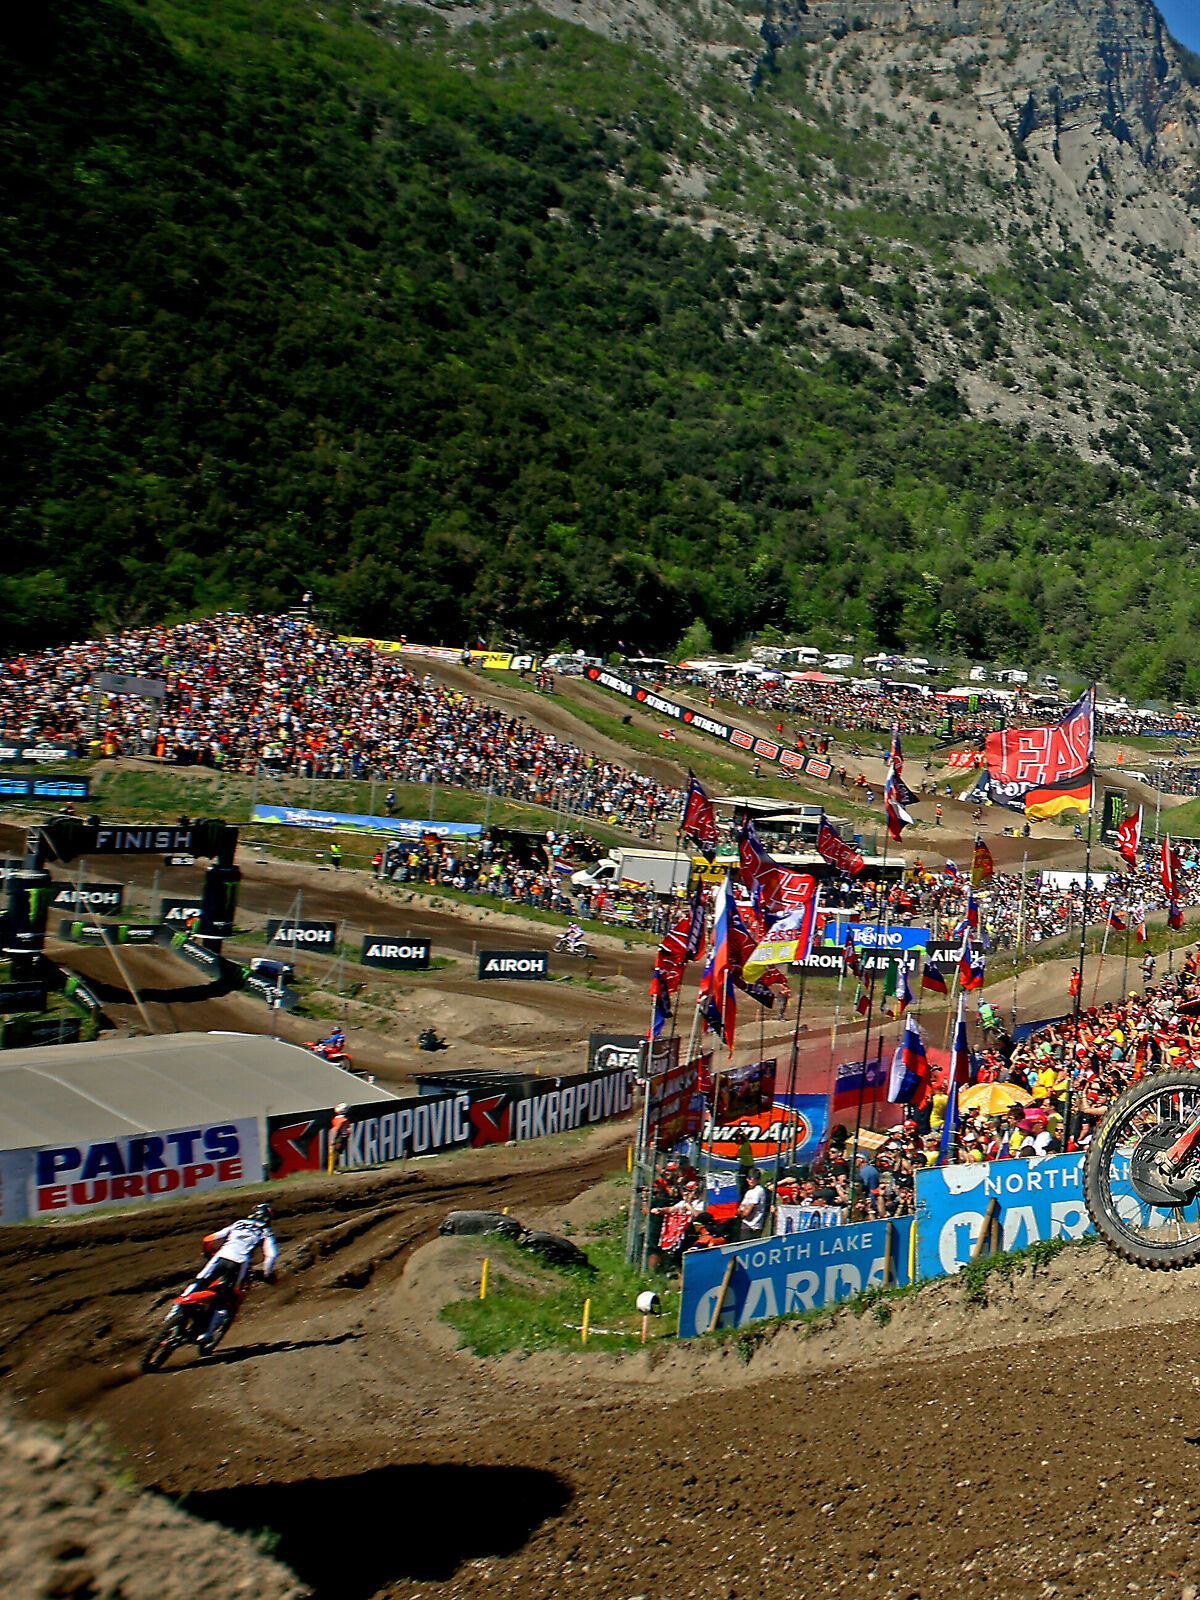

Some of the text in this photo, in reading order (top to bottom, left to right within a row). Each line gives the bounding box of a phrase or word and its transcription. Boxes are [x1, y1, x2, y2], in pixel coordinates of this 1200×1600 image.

[598, 673, 633, 696] ATHENA
[643, 695, 680, 718] ATHENA
[691, 715, 728, 738] ATHENA
[96, 831, 193, 848] FINISH
[55, 890, 120, 904] AIROH
[274, 928, 544, 973] AIROH AIROH AIROH
[606, 1053, 640, 1067] AFA
[340, 1091, 470, 1168] KRAPOVIČ
[37, 1124, 241, 1186] PARTS
[37, 1157, 243, 1211] EUROPE
[984, 1168, 1082, 1196] NORTH
[735, 1232, 874, 1271] NORTH LAKE
